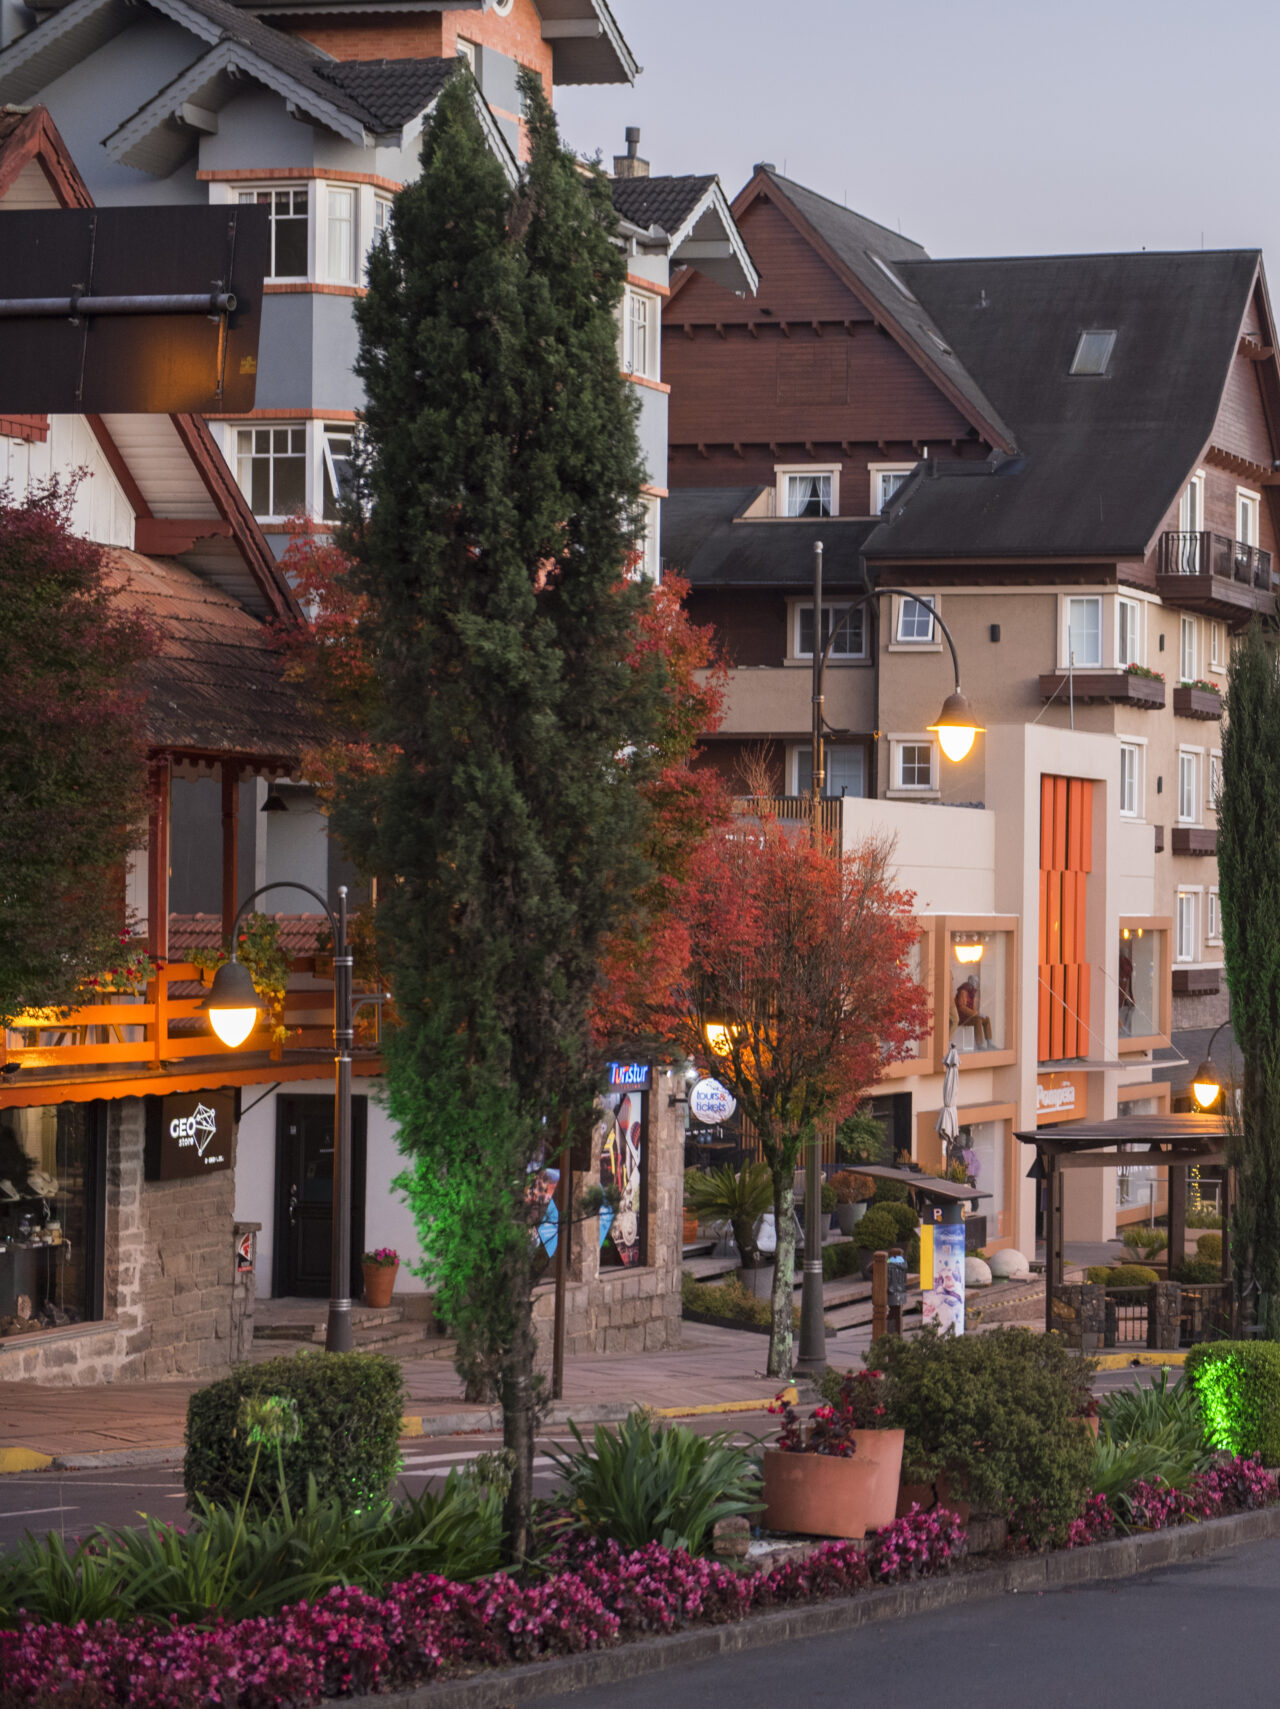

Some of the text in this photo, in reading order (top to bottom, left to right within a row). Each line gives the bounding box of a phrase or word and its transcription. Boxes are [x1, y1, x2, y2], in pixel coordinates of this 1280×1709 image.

[610, 1062, 649, 1085] Turistur
[696, 1102, 726, 1112] tickets
[170, 1116, 196, 1138] GEO
[178, 1137, 194, 1148] store
[933, 1207, 943, 1221] P
